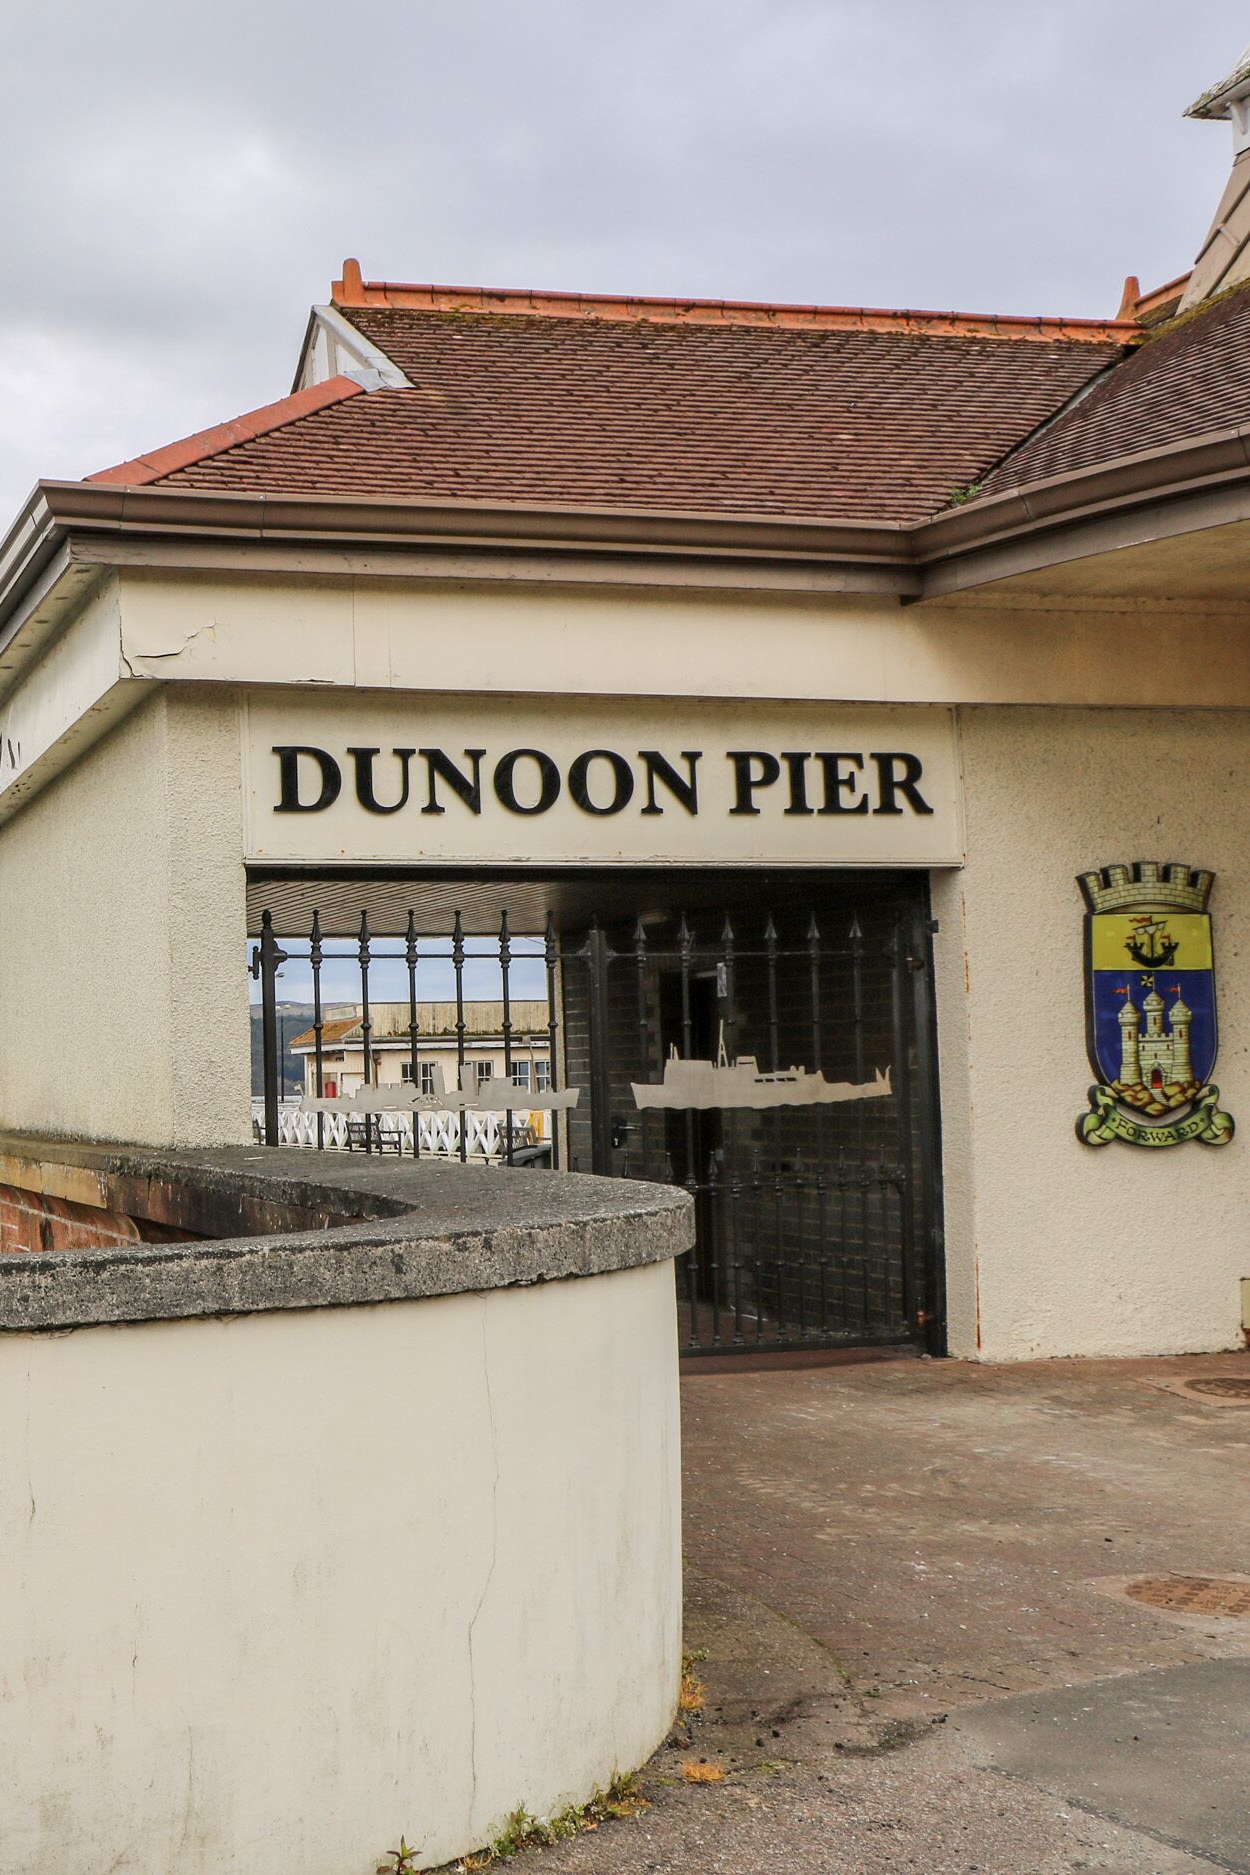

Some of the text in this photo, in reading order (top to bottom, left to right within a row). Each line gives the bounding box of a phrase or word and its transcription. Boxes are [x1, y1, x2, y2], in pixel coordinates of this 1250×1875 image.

[272, 746, 934, 817] DUNOON PIER
[1115, 1117, 1200, 1143] FORWARD
